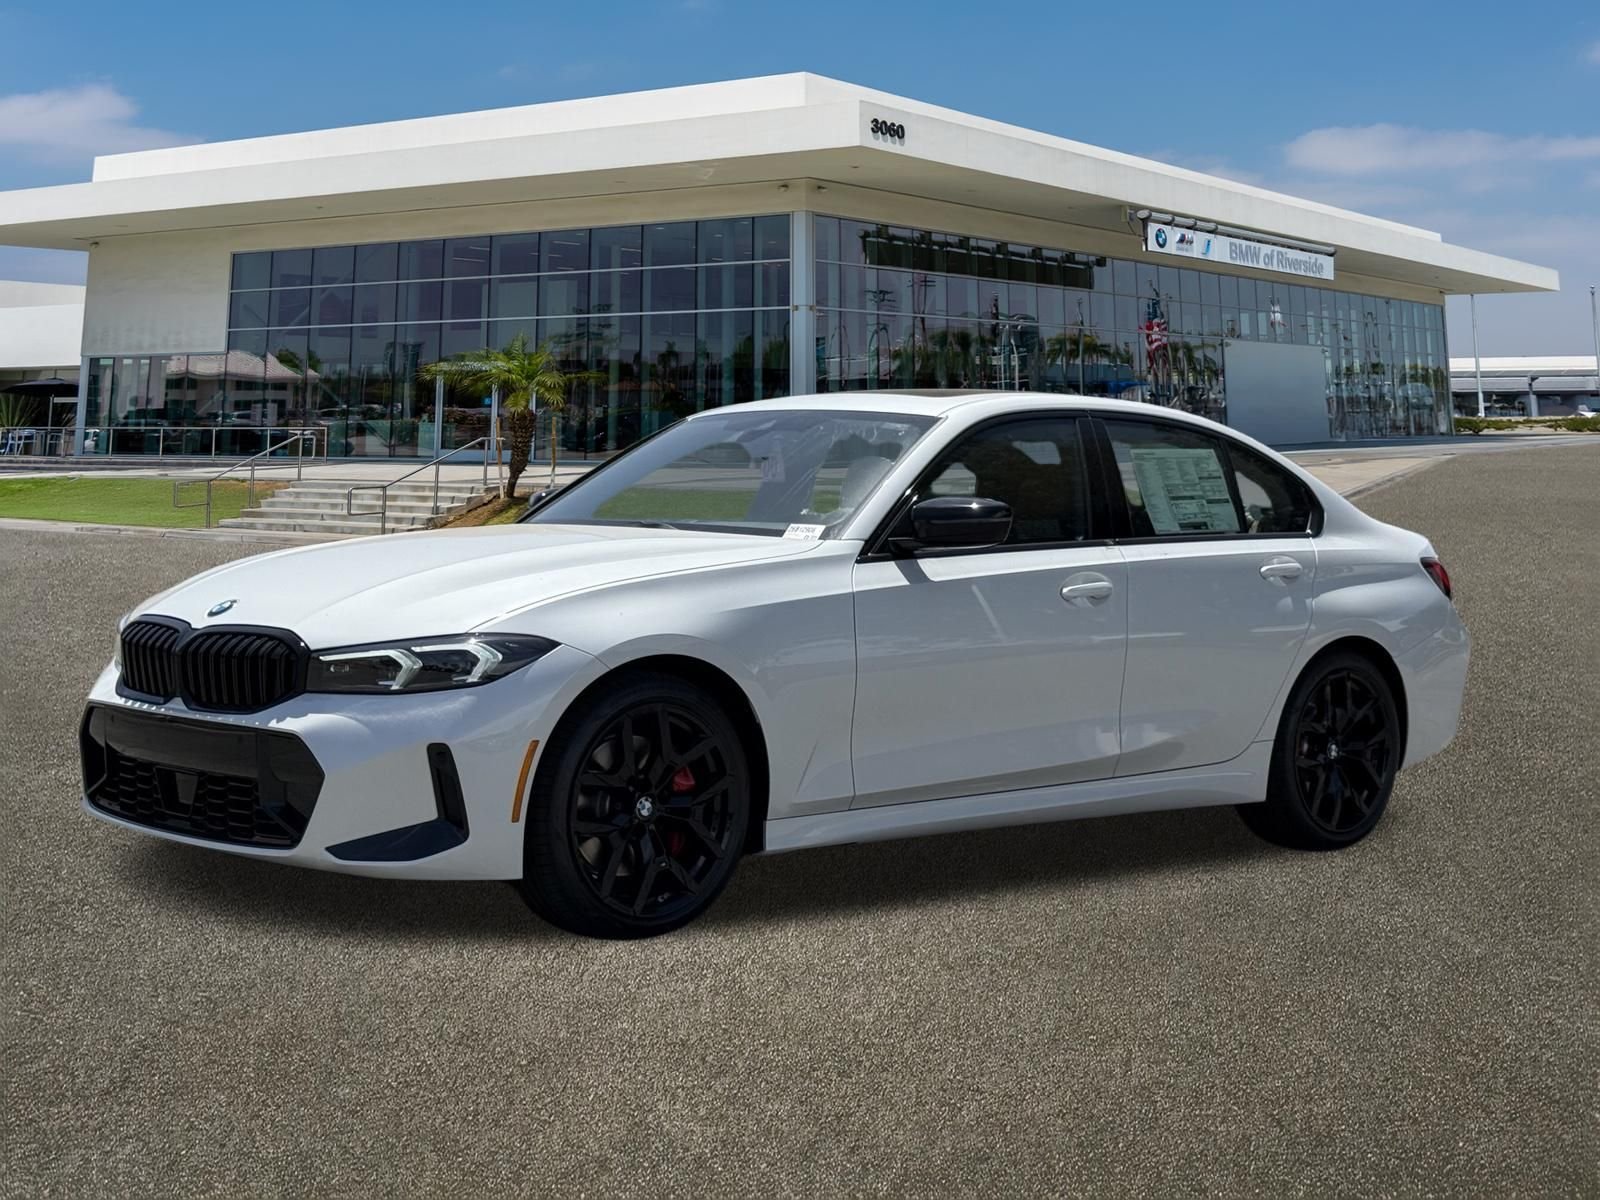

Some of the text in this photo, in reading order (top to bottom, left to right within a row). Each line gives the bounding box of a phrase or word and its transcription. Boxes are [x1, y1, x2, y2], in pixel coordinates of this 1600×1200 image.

[871, 118, 905, 139] 3060
[1229, 241, 1260, 265] BMW
[1263, 249, 1275, 268] of
[1277, 250, 1324, 275] Riverside
